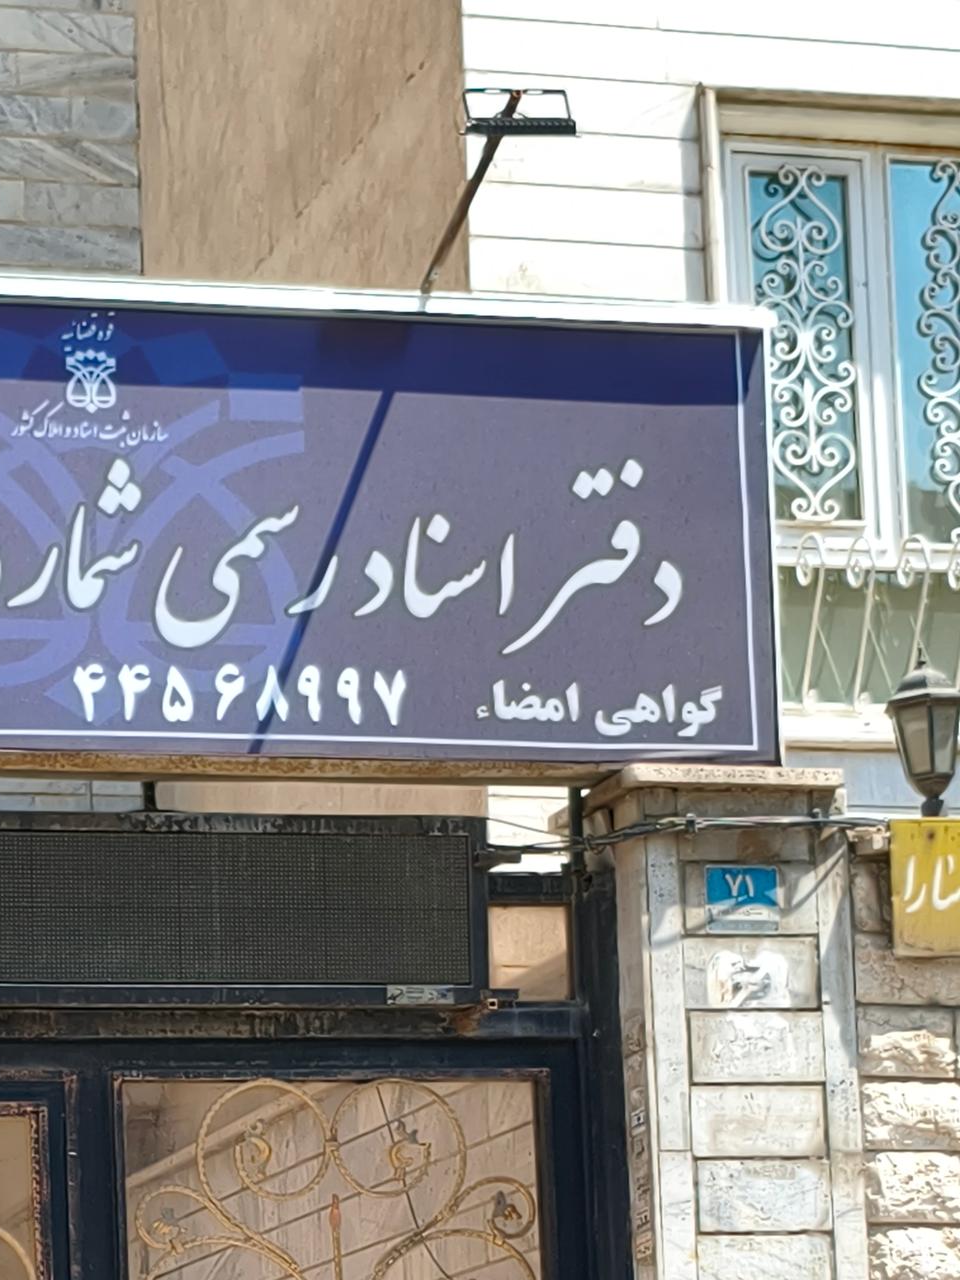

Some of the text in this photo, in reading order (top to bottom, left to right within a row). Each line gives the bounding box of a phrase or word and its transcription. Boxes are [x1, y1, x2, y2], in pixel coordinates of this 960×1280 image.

[10, 399, 49, 438] کشور
[33, 400, 65, 439] املاک
[73, 421, 98, 439] اسناد
[98, 409, 131, 448] ثبت
[125, 420, 169, 446] سازمان
[353, 513, 516, 619] اسناد
[502, 458, 684, 655] دفتر
[154, 504, 338, 649] رسمی
[73, 663, 408, 728] ۴۴۵۶۸۹۹۷
[476, 680, 724, 738] گواهی امضاء
[725, 873, 755, 898] ۷۱
